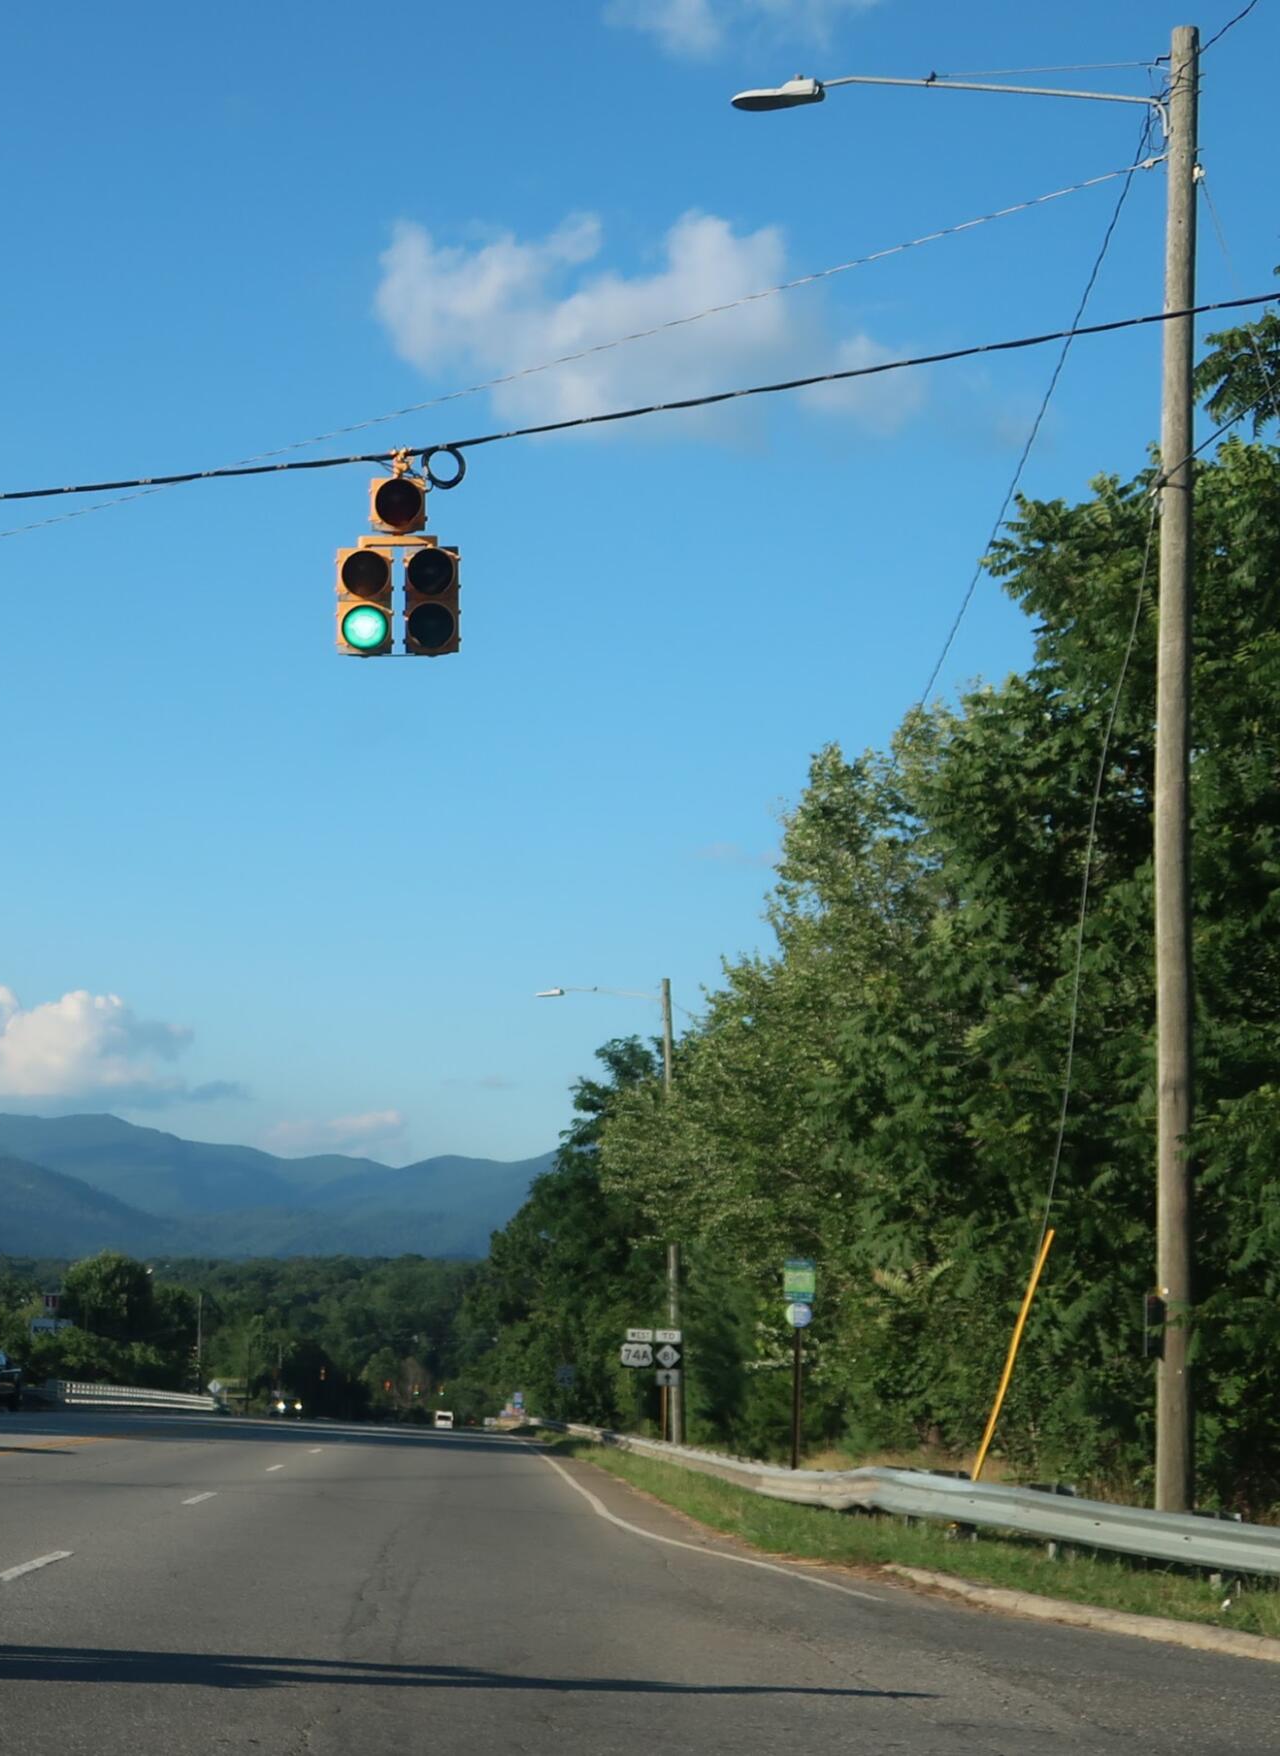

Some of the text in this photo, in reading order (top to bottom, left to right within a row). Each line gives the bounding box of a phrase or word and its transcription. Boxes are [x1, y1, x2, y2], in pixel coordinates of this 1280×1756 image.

[630, 1331, 651, 1339] WEST
[661, 1332, 675, 1340] TO
[624, 1348, 650, 1361] 74A
[662, 1351, 674, 1361] 81
